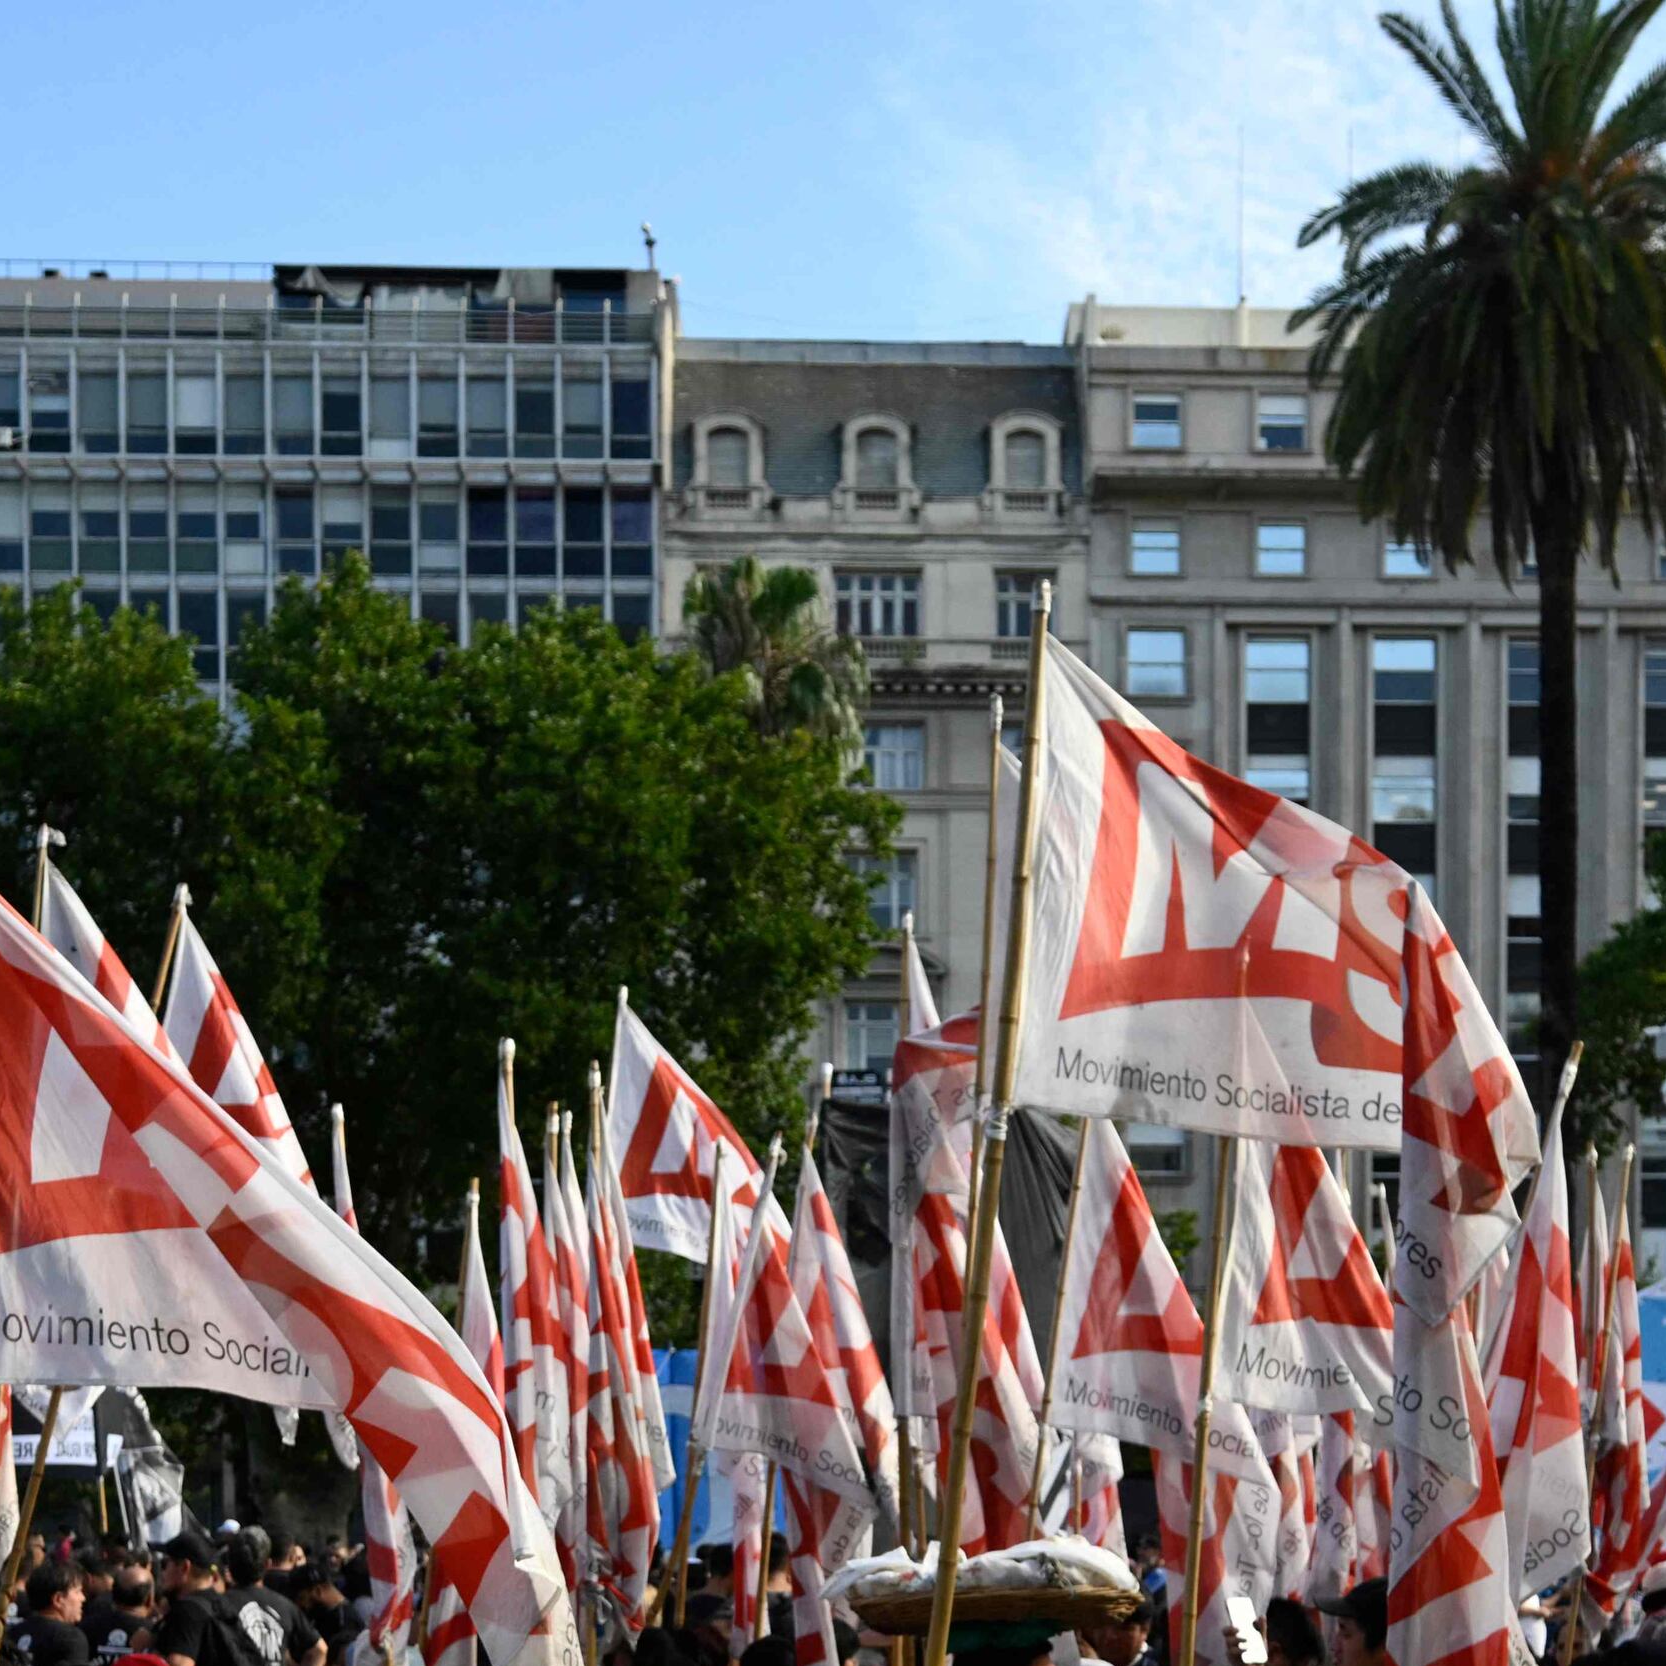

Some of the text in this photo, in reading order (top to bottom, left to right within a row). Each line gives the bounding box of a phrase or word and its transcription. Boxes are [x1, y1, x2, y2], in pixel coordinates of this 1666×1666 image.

[1055, 1046, 1403, 1124] Movimiento Socialista de
[1064, 1378, 1183, 1437] Movimiento
